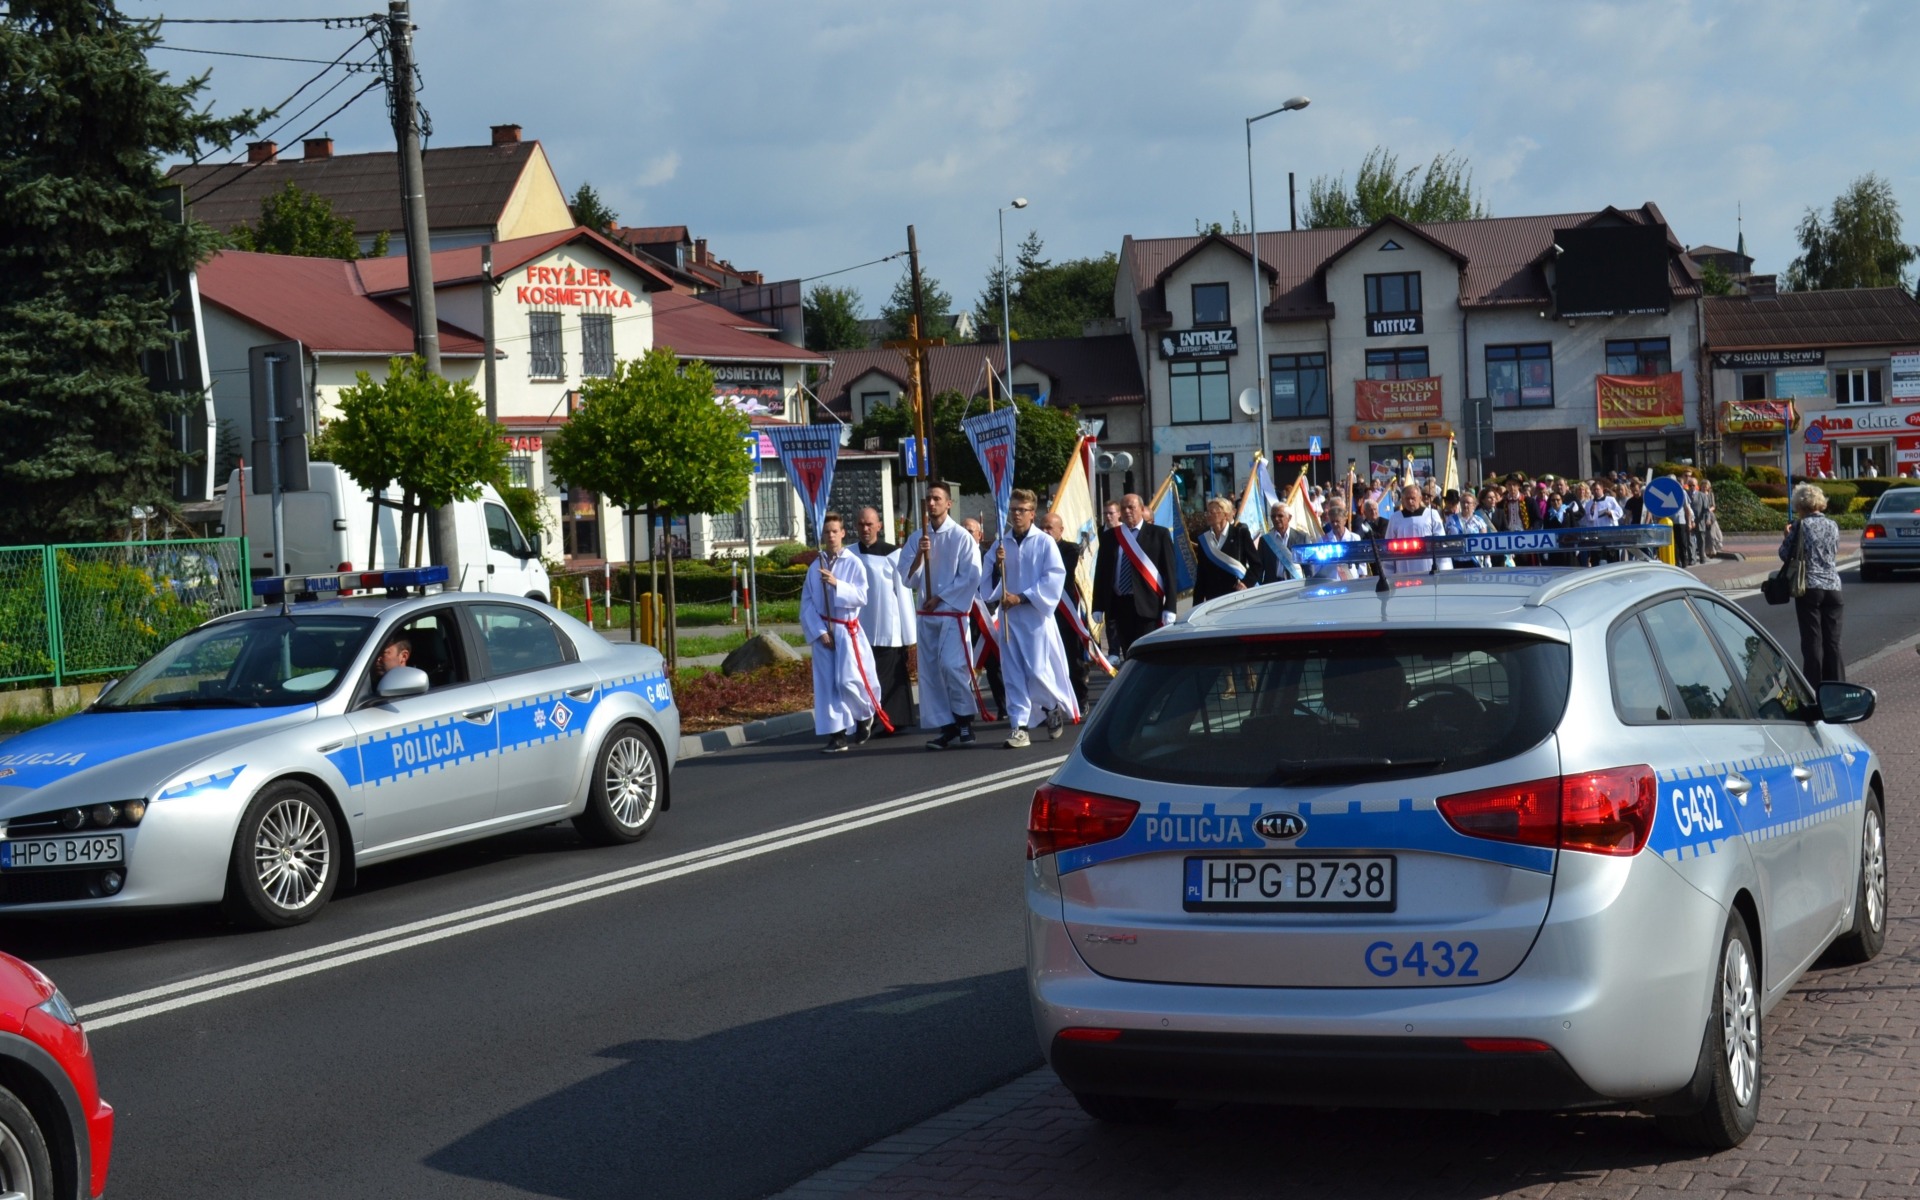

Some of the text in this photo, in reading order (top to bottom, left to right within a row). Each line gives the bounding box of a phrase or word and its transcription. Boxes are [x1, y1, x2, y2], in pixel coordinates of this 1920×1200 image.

[517, 286, 633, 308] KOSMETYKA
[1180, 330, 1233, 346] INTRUZ
[1733, 350, 1822, 362] SIGNUM Serwis
[711, 366, 781, 381] KOSMETYKA
[1390, 391, 1432, 403] SKLEP
[1601, 397, 1658, 412] SKLEP
[1742, 420, 1774, 431] AGD
[1810, 414, 1853, 431] okna
[1857, 411, 1900, 429] okna
[1466, 532, 1555, 552] POLICJA
[306, 576, 339, 592] POLICJA
[646, 682, 669, 703] G 402
[391, 728, 465, 769] POLICJA
[1672, 785, 1724, 837] G432
[1146, 816, 1243, 843] POLICJA
[1261, 817, 1298, 834] KIA
[13, 838, 118, 865] HPG B495
[1207, 861, 1385, 899] HPG B738
[1188, 886, 1200, 896] PL
[1364, 941, 1480, 977] G432
